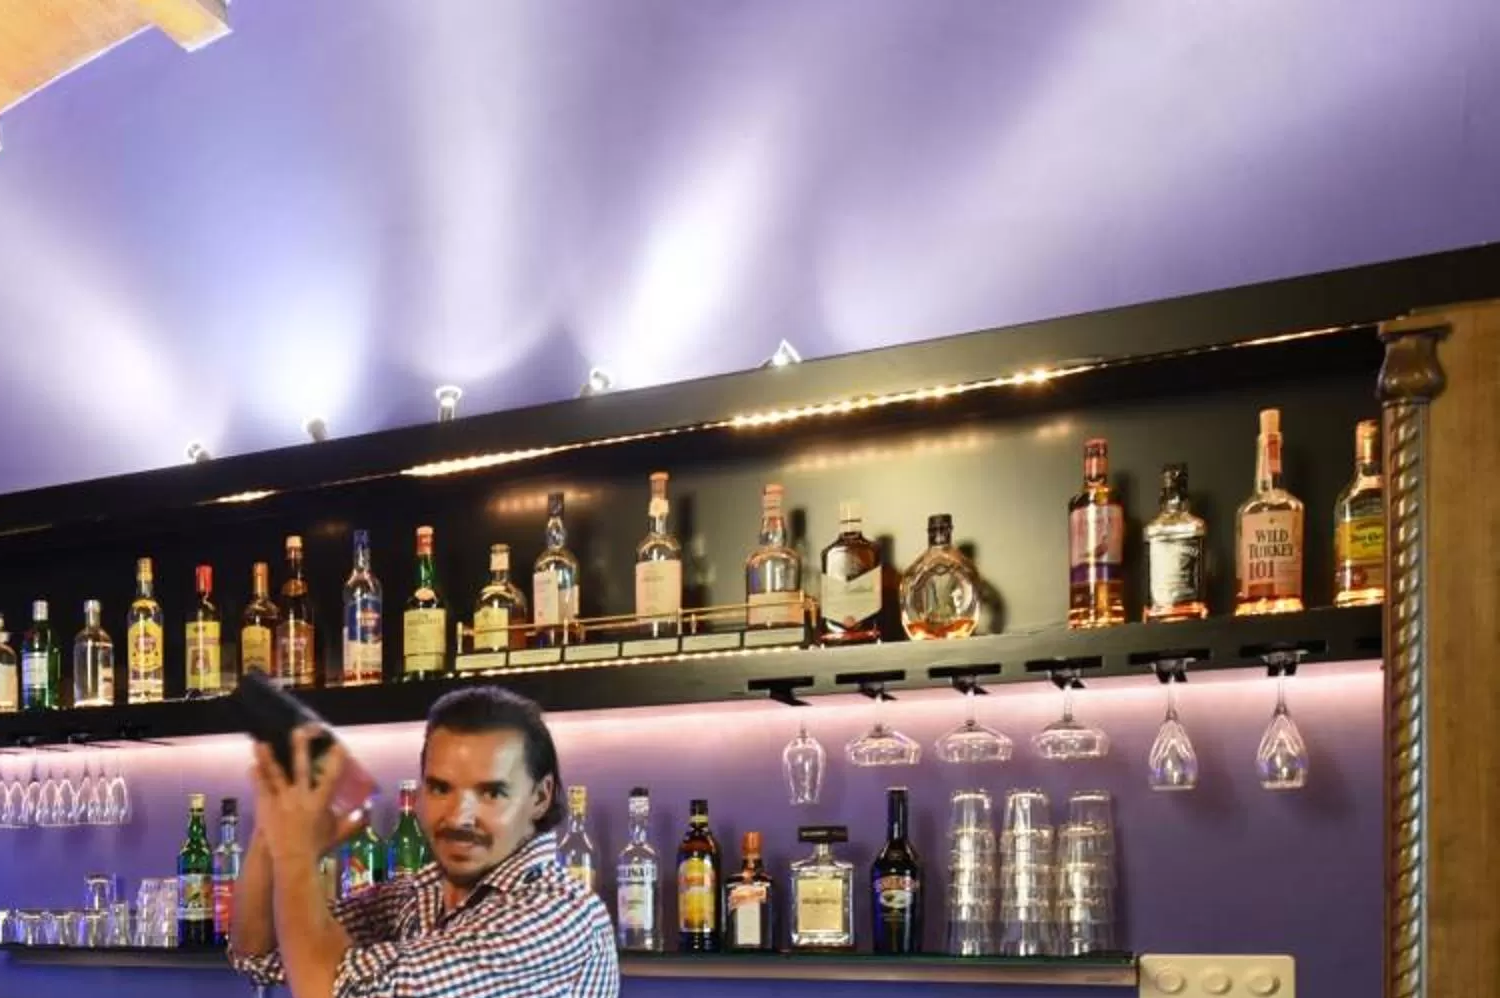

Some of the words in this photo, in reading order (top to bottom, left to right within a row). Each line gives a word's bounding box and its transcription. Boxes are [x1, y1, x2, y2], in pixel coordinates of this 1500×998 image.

[1255, 528, 1289, 542] WILD
[1249, 543, 1294, 559] TURKEY
[1249, 560, 1275, 580] 101
